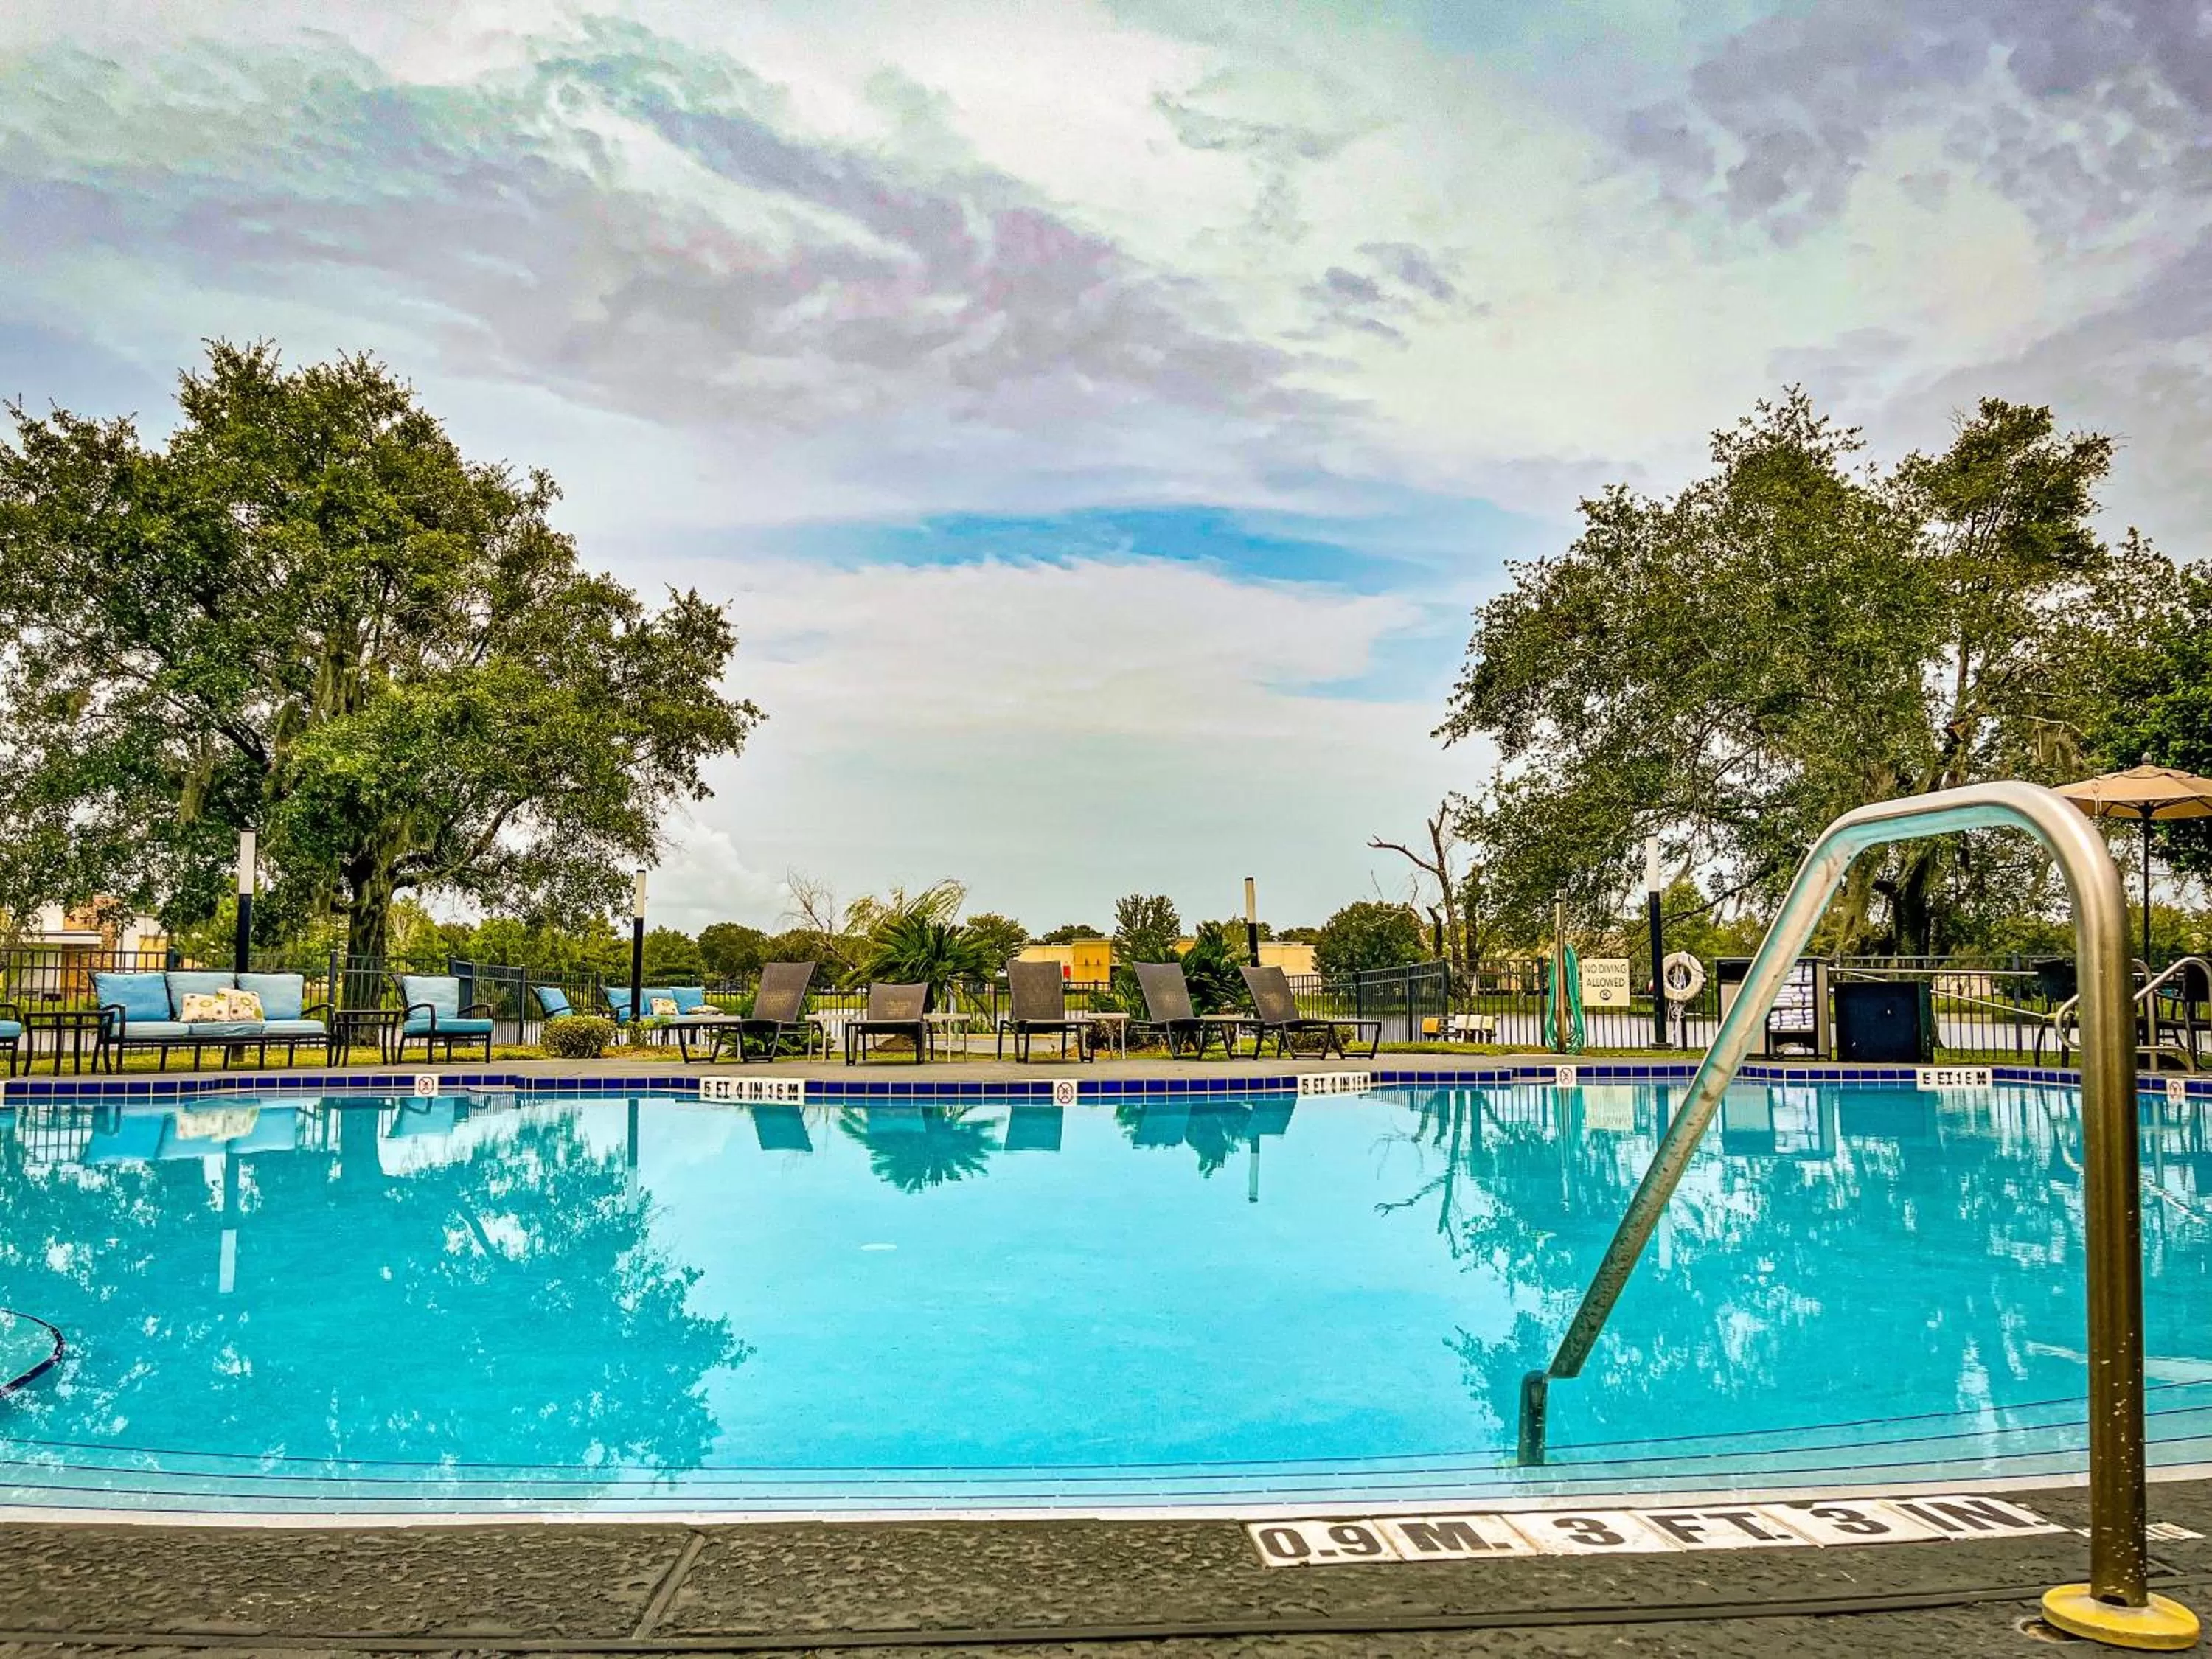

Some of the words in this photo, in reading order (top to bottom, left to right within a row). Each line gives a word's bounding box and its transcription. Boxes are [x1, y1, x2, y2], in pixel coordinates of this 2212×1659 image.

[1584, 964, 1597, 973] NO
[1598, 964, 1627, 973] DIVING
[1586, 977, 1626, 987] ALLOWED
[1258, 1525, 1382, 1558] 0.9
[1397, 1521, 1514, 1552] M.
[1552, 1517, 1626, 1546] 3
[1646, 1512, 1794, 1543] FT.
[1809, 1508, 1891, 1534] 3
[1896, 1500, 2051, 1532] IN.
